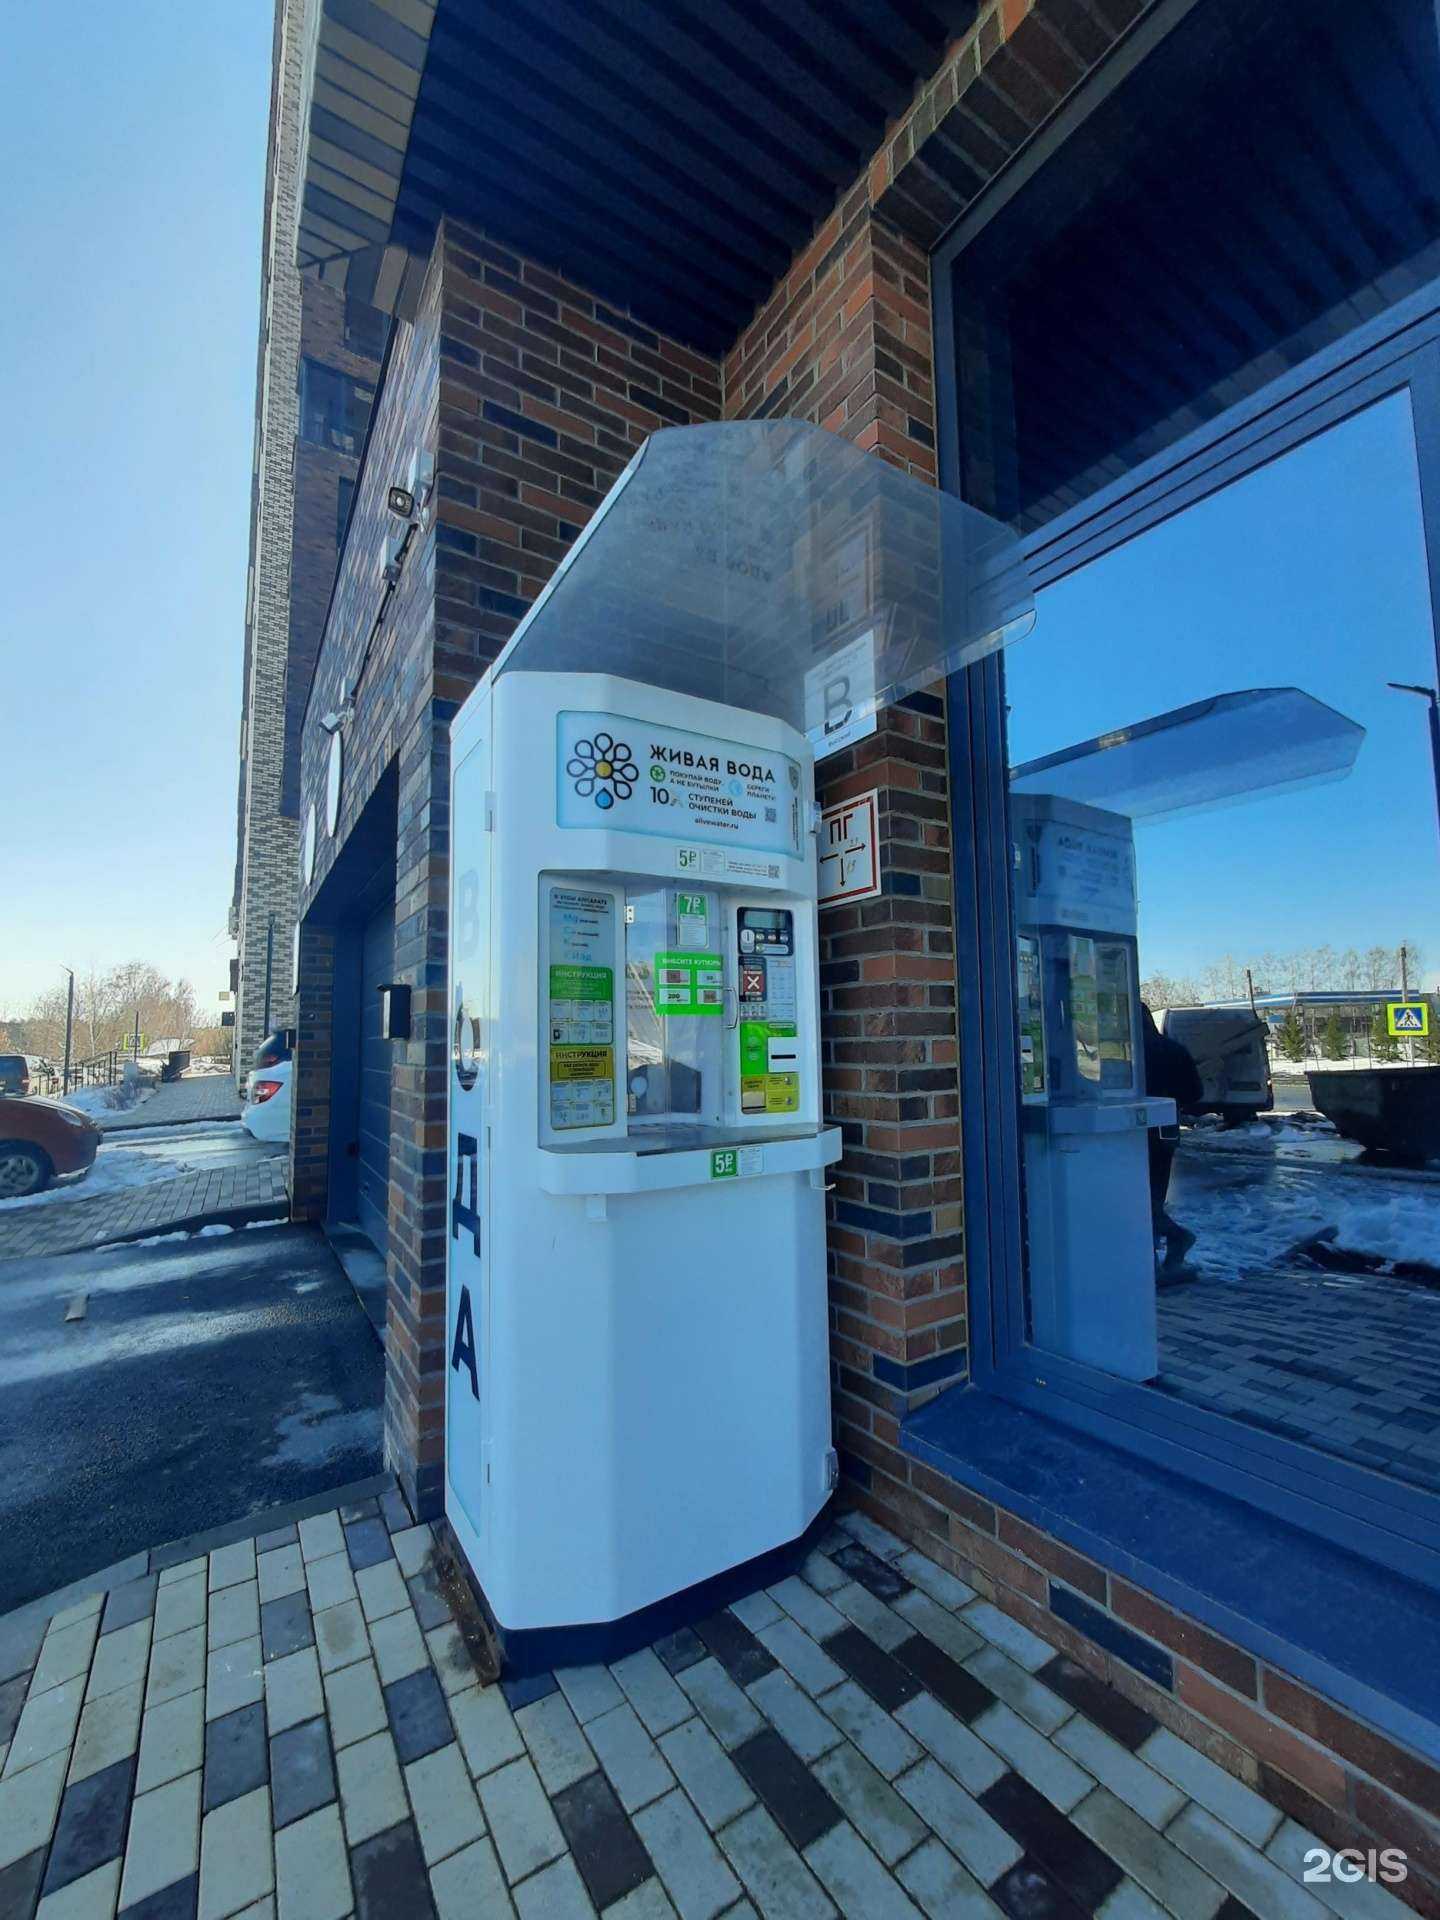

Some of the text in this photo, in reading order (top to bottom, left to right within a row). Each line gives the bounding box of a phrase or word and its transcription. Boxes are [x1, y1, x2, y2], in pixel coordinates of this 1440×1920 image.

[650, 744, 776, 783] ЖИВАЯ ВОДА
[669, 770, 703, 782] ПОКУПАЙ
[650, 786, 670, 805] 10
[688, 793, 734, 807] СТУПЕНЕЙ
[688, 802, 757, 820] ОЧИСТКИ ВОДЫ
[829, 813, 853, 845] ПГ
